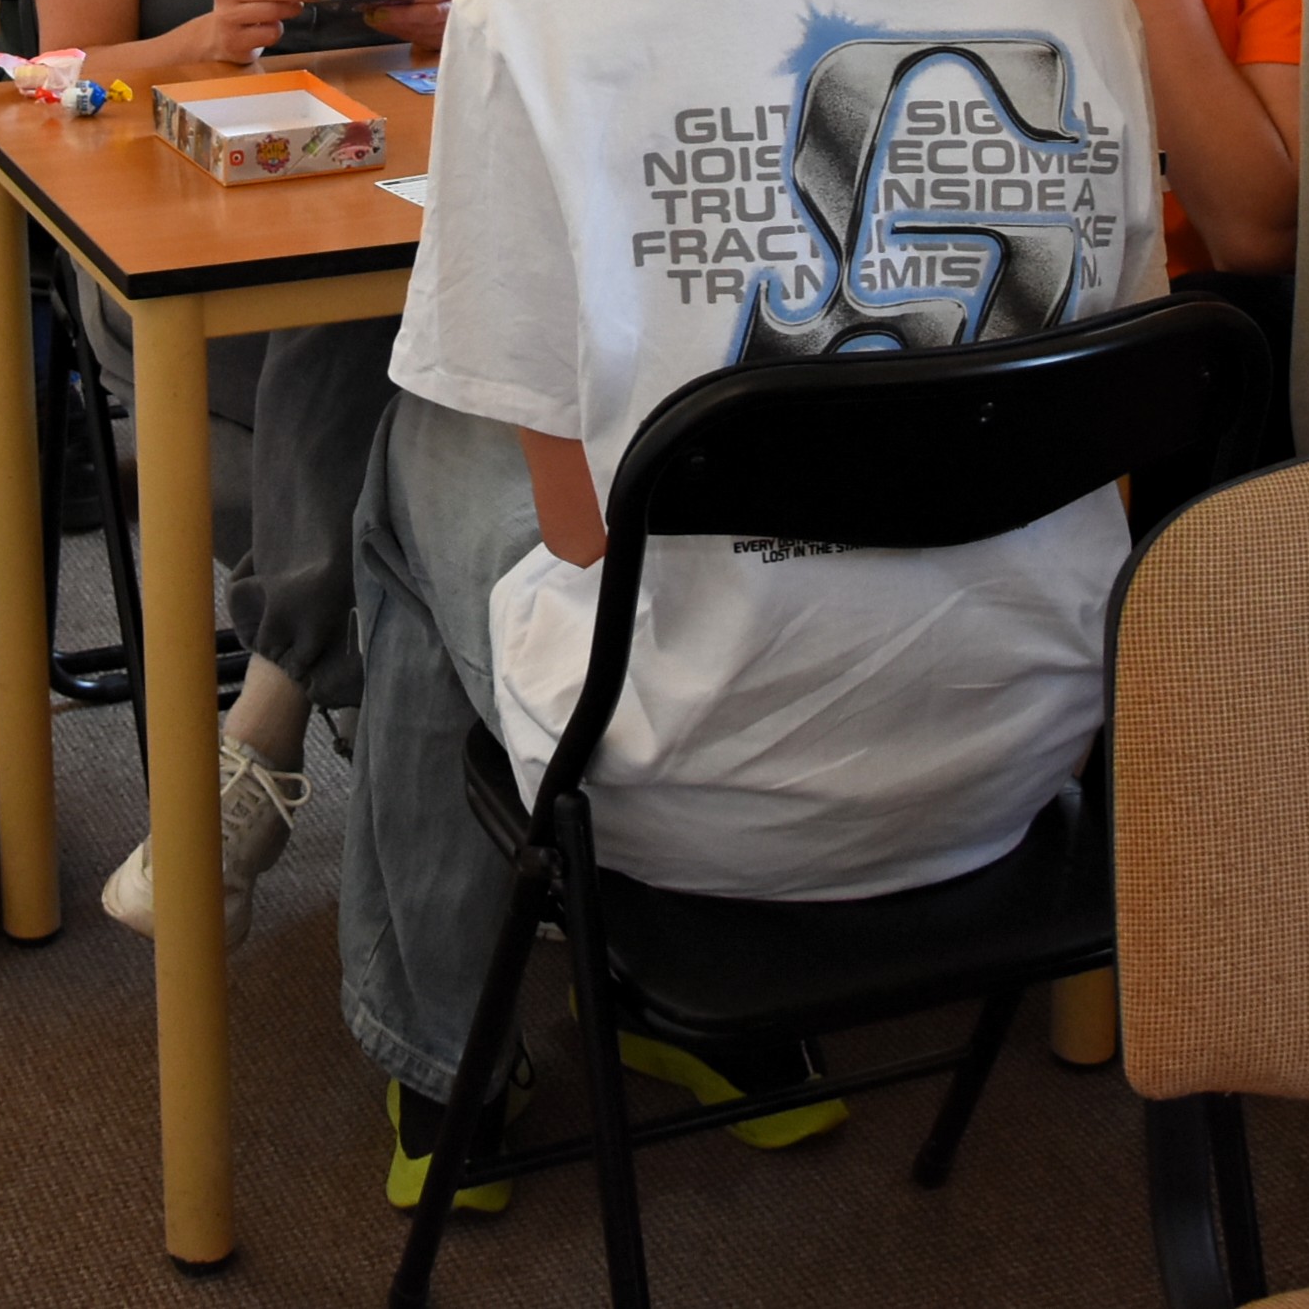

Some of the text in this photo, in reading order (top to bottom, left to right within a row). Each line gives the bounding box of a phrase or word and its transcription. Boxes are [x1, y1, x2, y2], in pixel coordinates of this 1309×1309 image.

[674, 104, 791, 145] GLIT
[643, 139, 1120, 187] NOIS ECOMES
[872, 178, 1067, 215] NSIDE
[1073, 178, 1096, 213] A
[733, 538, 776, 554] EVERY
[761, 548, 791, 564] LOST
[793, 546, 806, 558] IN
[808, 542, 833, 556] THE
